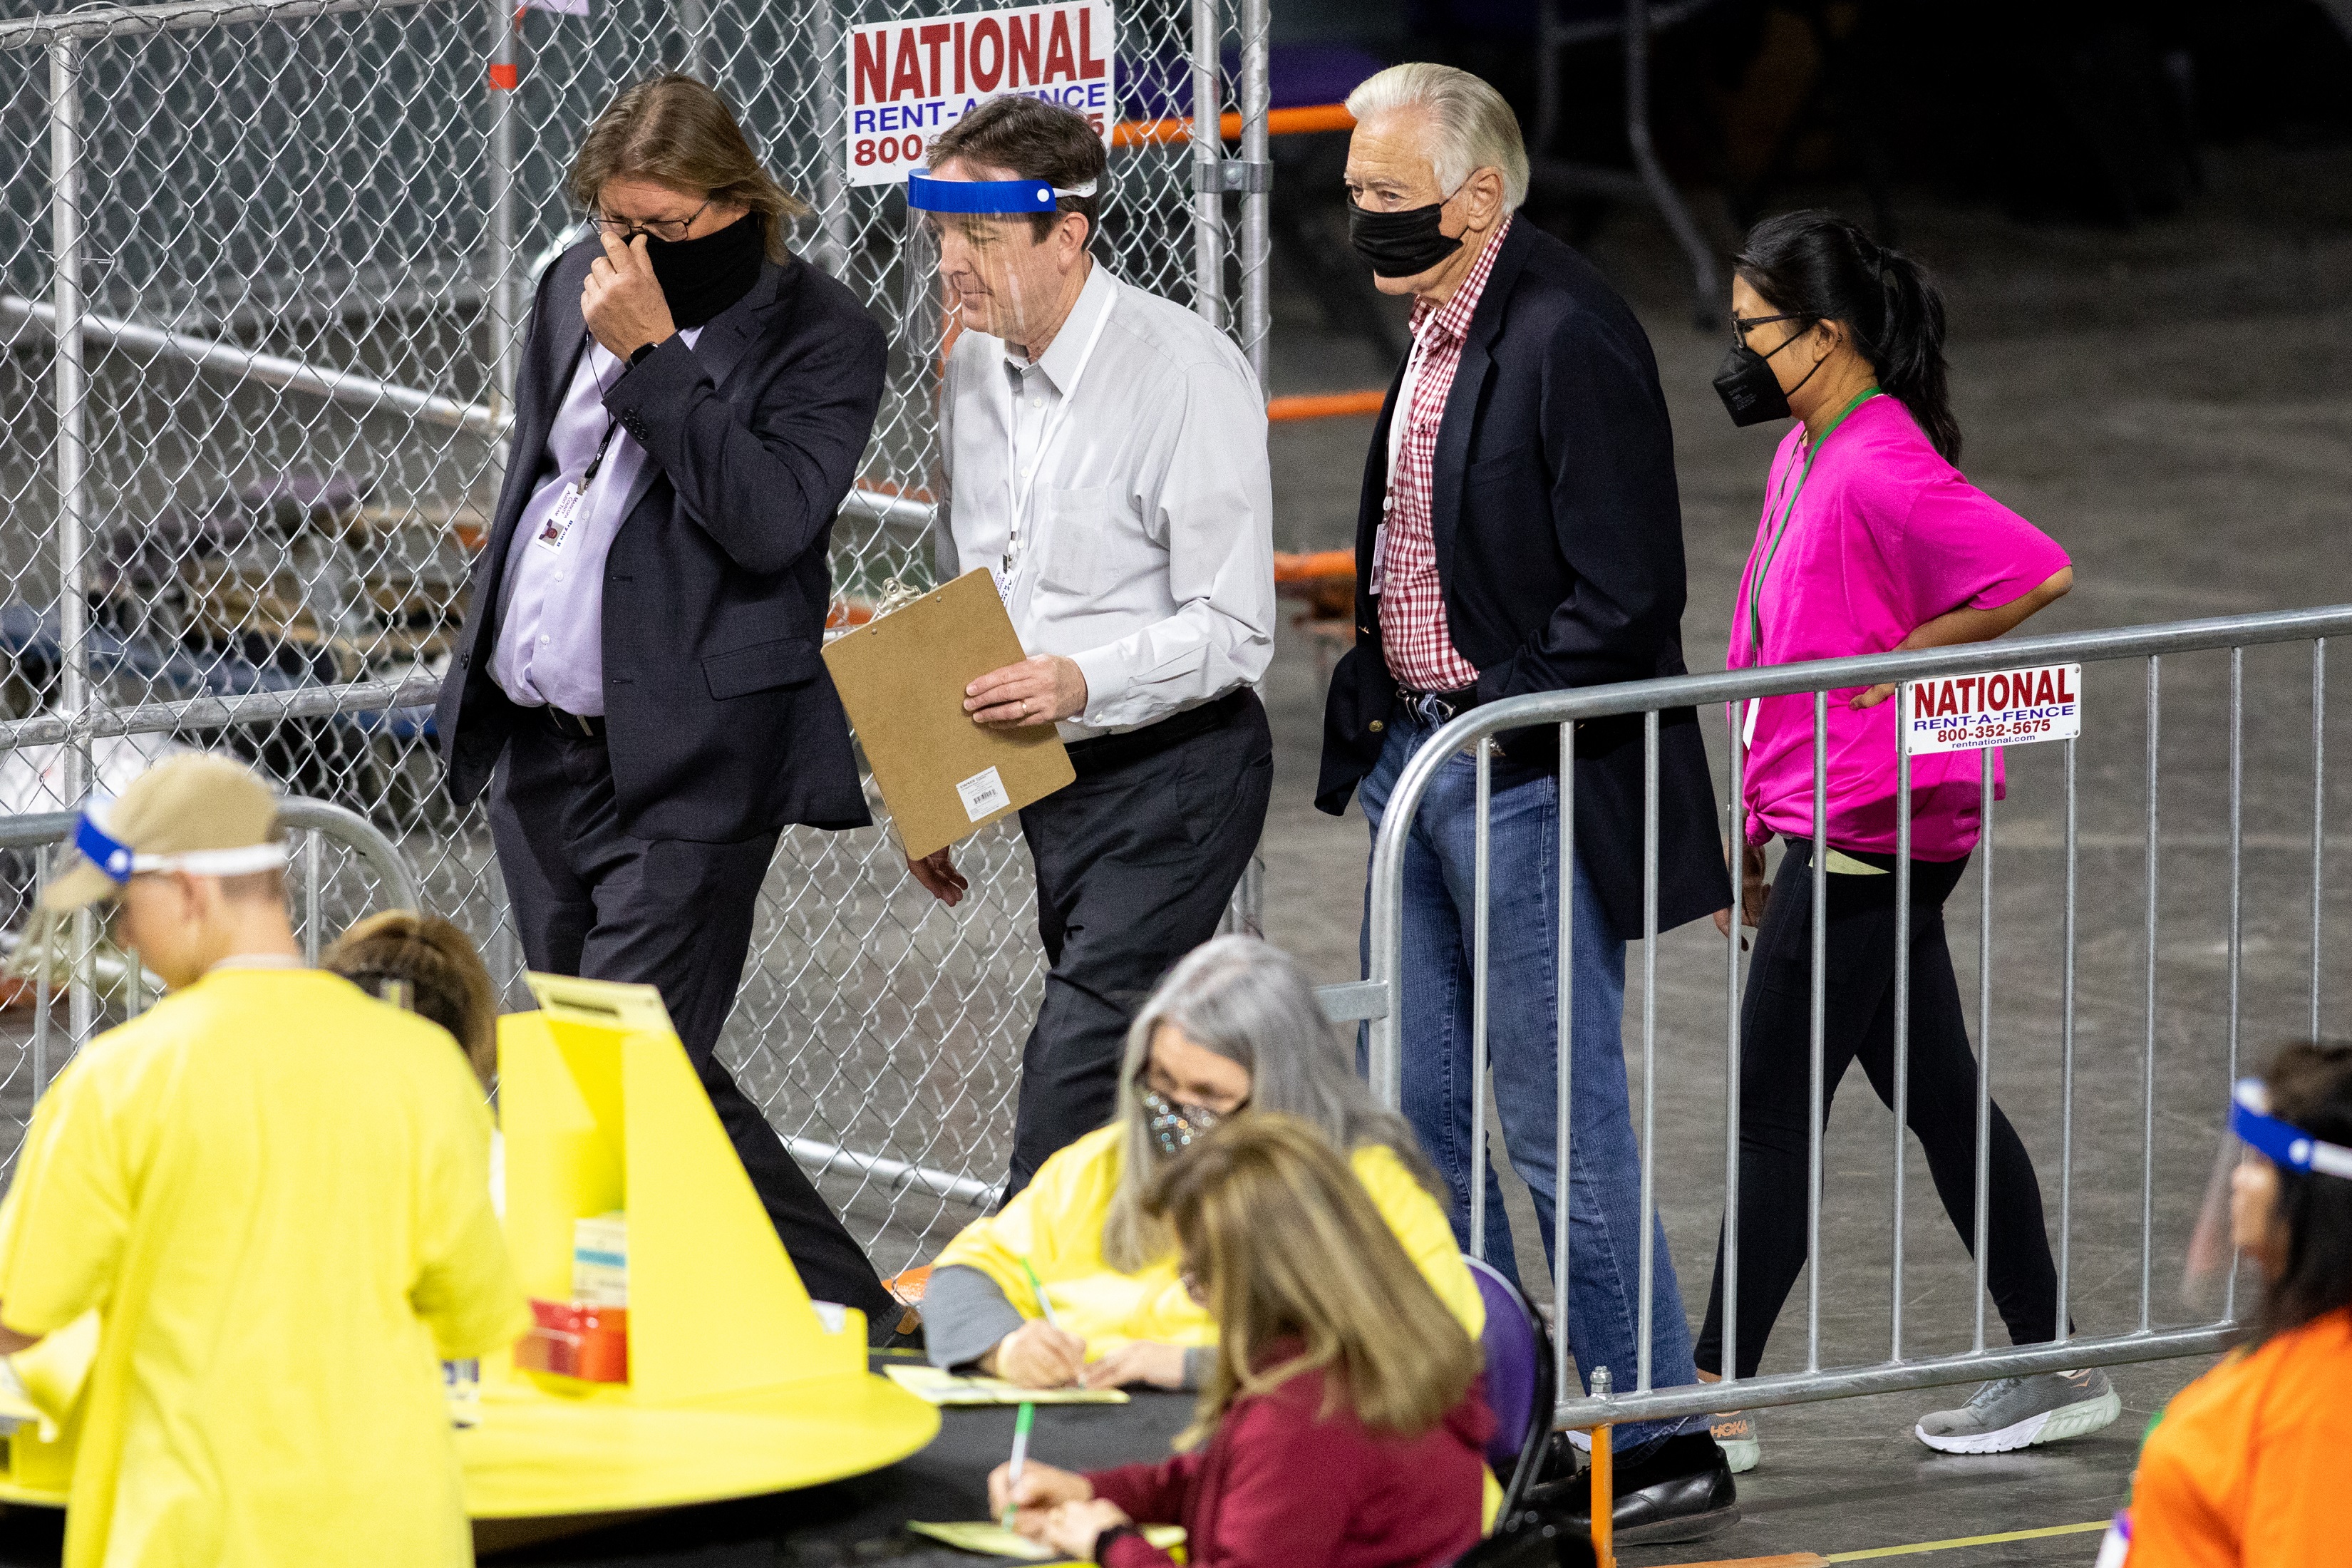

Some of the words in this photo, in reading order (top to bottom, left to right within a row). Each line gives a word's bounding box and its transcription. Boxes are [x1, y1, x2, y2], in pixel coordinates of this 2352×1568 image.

[854, 7, 1105, 105] NATIONAL
[561, 490, 571, 505] AUDIT
[561, 497, 573, 514] COUNTY
[555, 504, 564, 517] TEAM
[560, 520, 573, 540] Bryan
[1914, 668, 2075, 719] NATIONAL
[1914, 705, 2075, 731] RENT-A-FENCE
[1937, 718, 2051, 743] 800-352-5675
[1951, 735, 2036, 748] rentnational.com
[1711, 1419, 1748, 1438] HOKA
